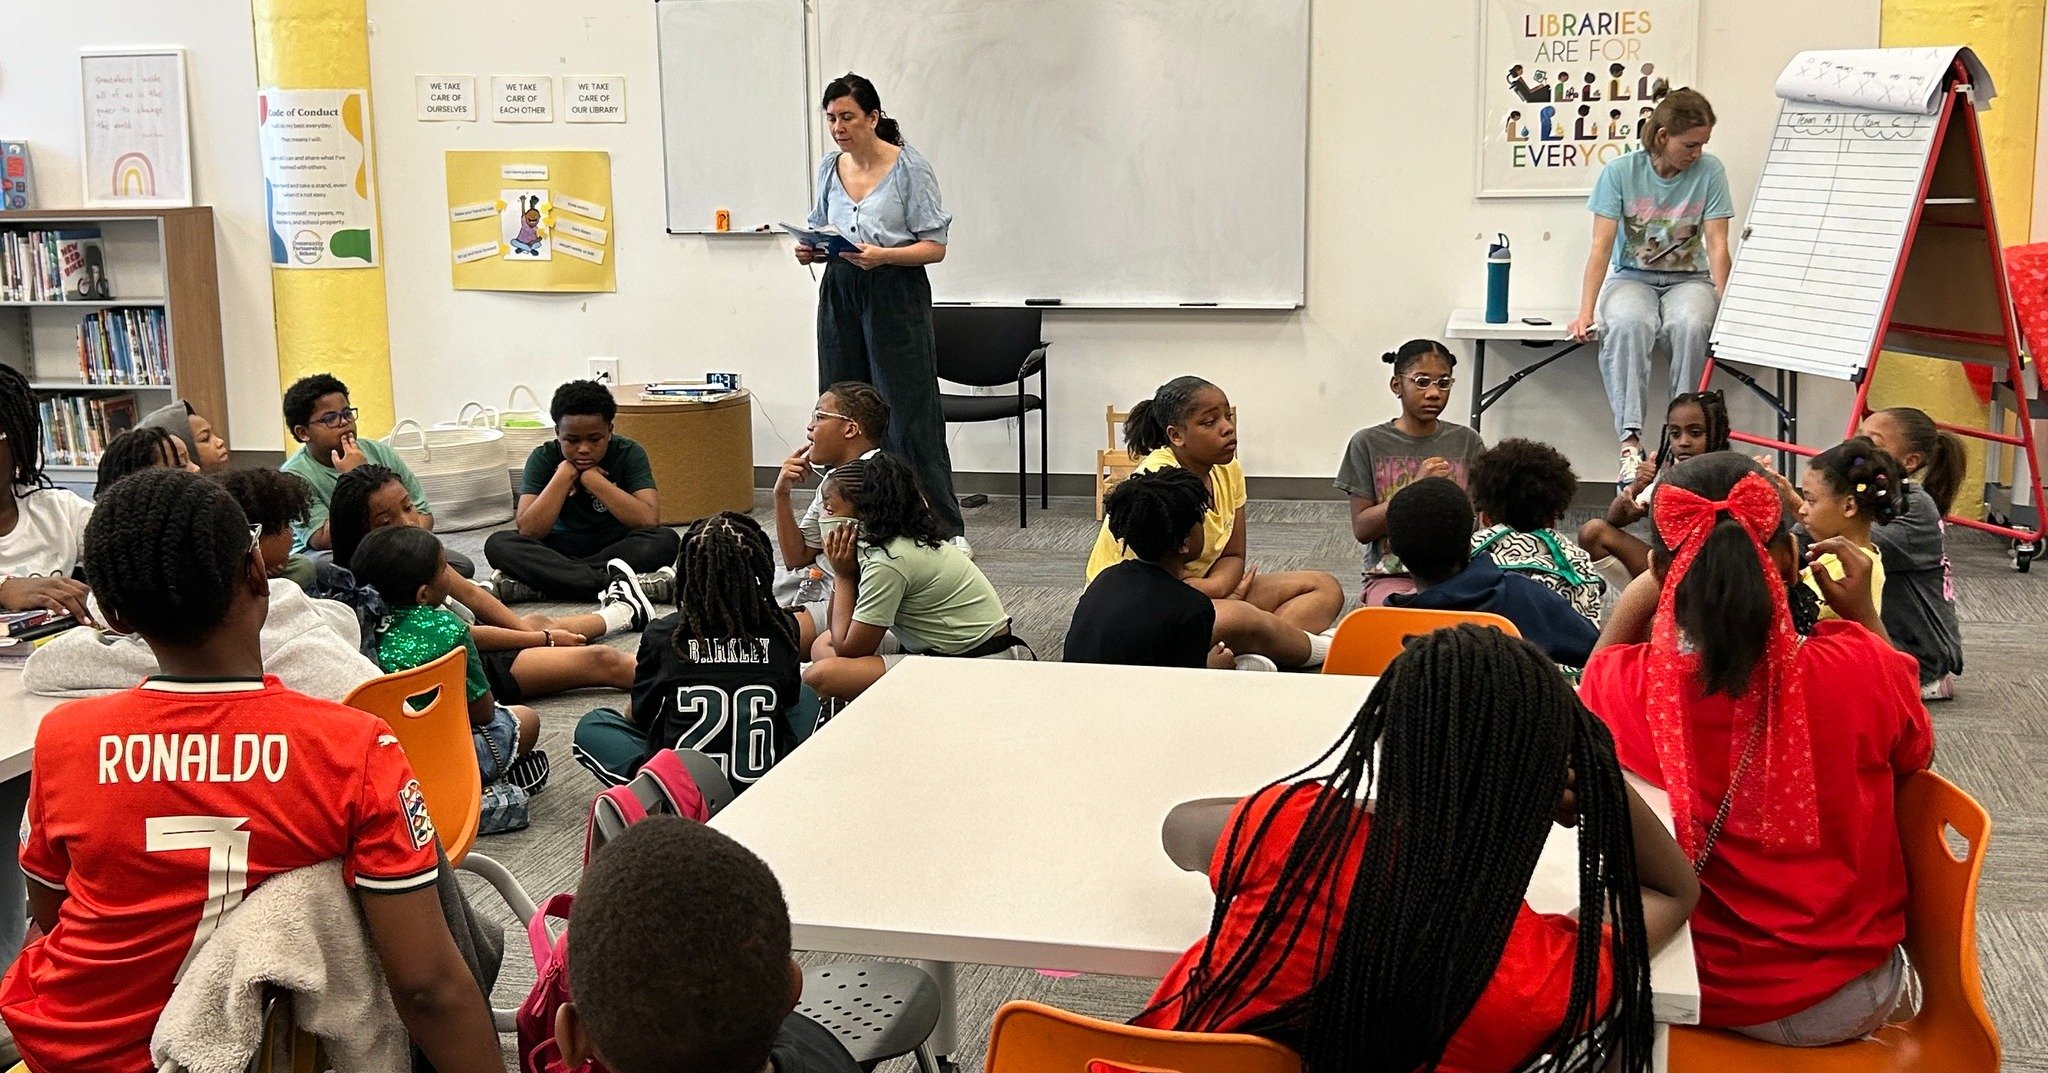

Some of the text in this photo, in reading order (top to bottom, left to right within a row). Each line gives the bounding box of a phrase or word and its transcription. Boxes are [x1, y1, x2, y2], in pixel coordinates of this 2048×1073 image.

[1525, 11, 1652, 38] LIBRARIES
[1534, 38, 1642, 63] ARE FOR
[505, 83, 537, 91] WE TAKE
[577, 83, 610, 91] WE TAKE
[578, 94, 610, 102] CARE OF
[286, 108, 296, 117] of
[297, 108, 339, 117] Conduct
[426, 105, 467, 113] OURSELVES
[499, 106, 546, 114] EACH OTHER
[571, 106, 619, 114] OUR LIBRARY
[1796, 113, 1832, 125] Team A
[1862, 114, 1880, 127] Team
[1512, 143, 1641, 168] EVERYO
[61, 242, 78, 256] NEW
[64, 252, 80, 265] RED
[64, 258, 85, 277] BIKE!
[687, 637, 770, 664] BARKLEY
[674, 685, 778, 783] 26
[98, 733, 289, 785] RONALDO
[145, 816, 252, 985] 7
